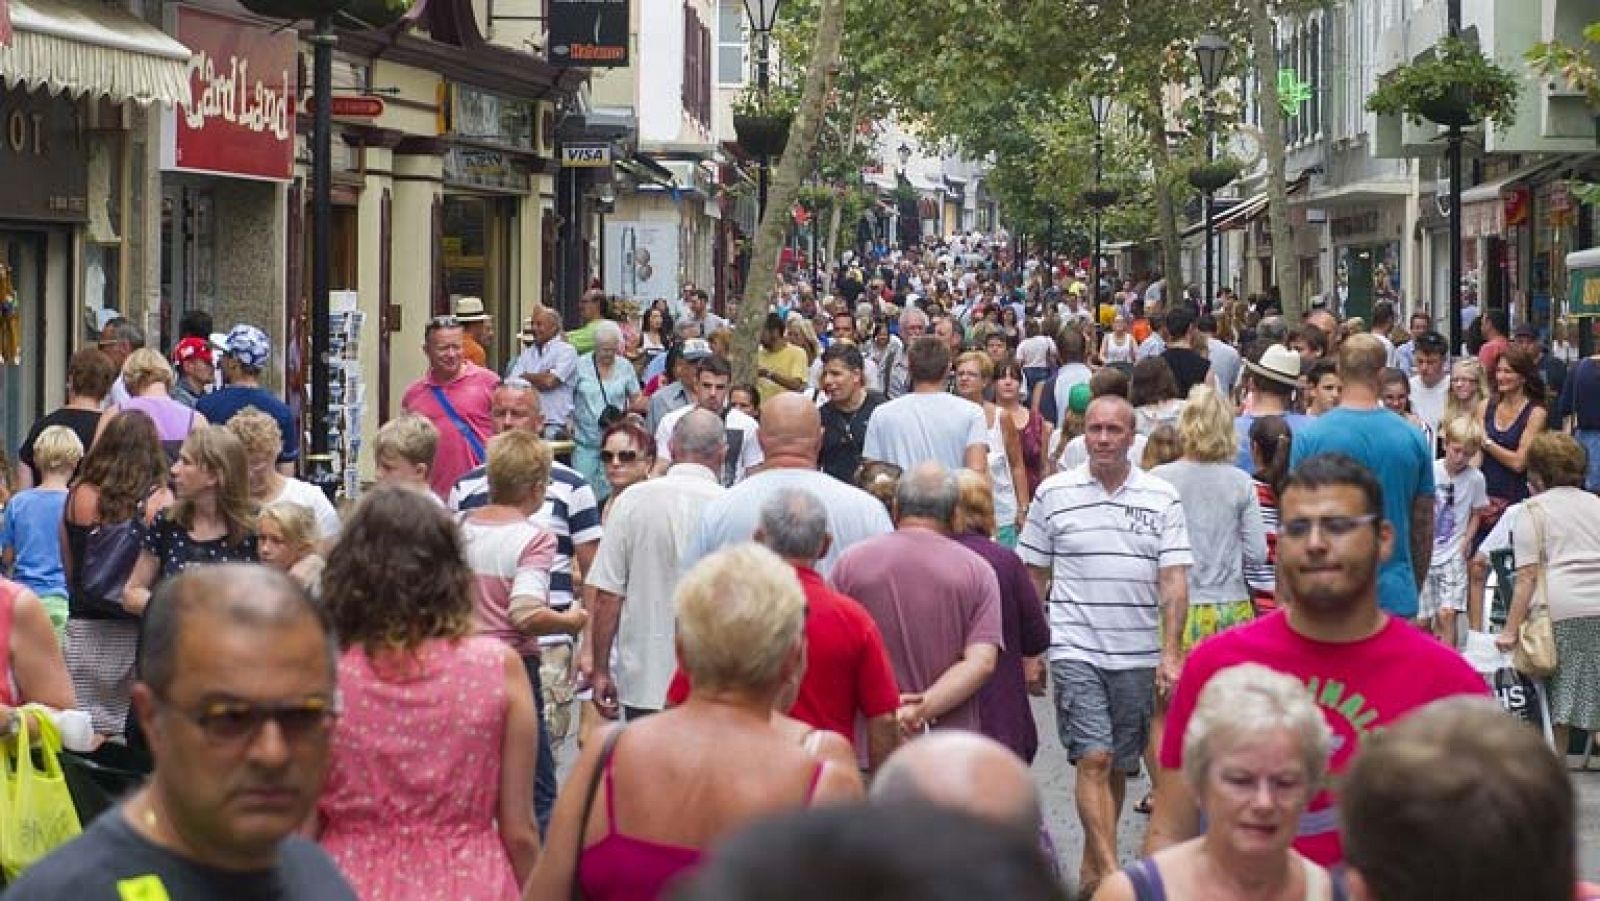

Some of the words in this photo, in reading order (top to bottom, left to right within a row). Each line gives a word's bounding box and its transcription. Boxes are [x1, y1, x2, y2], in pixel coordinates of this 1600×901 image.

[186, 50, 237, 129] Card
[239, 58, 289, 140] Land
[568, 149, 602, 161] VISA
